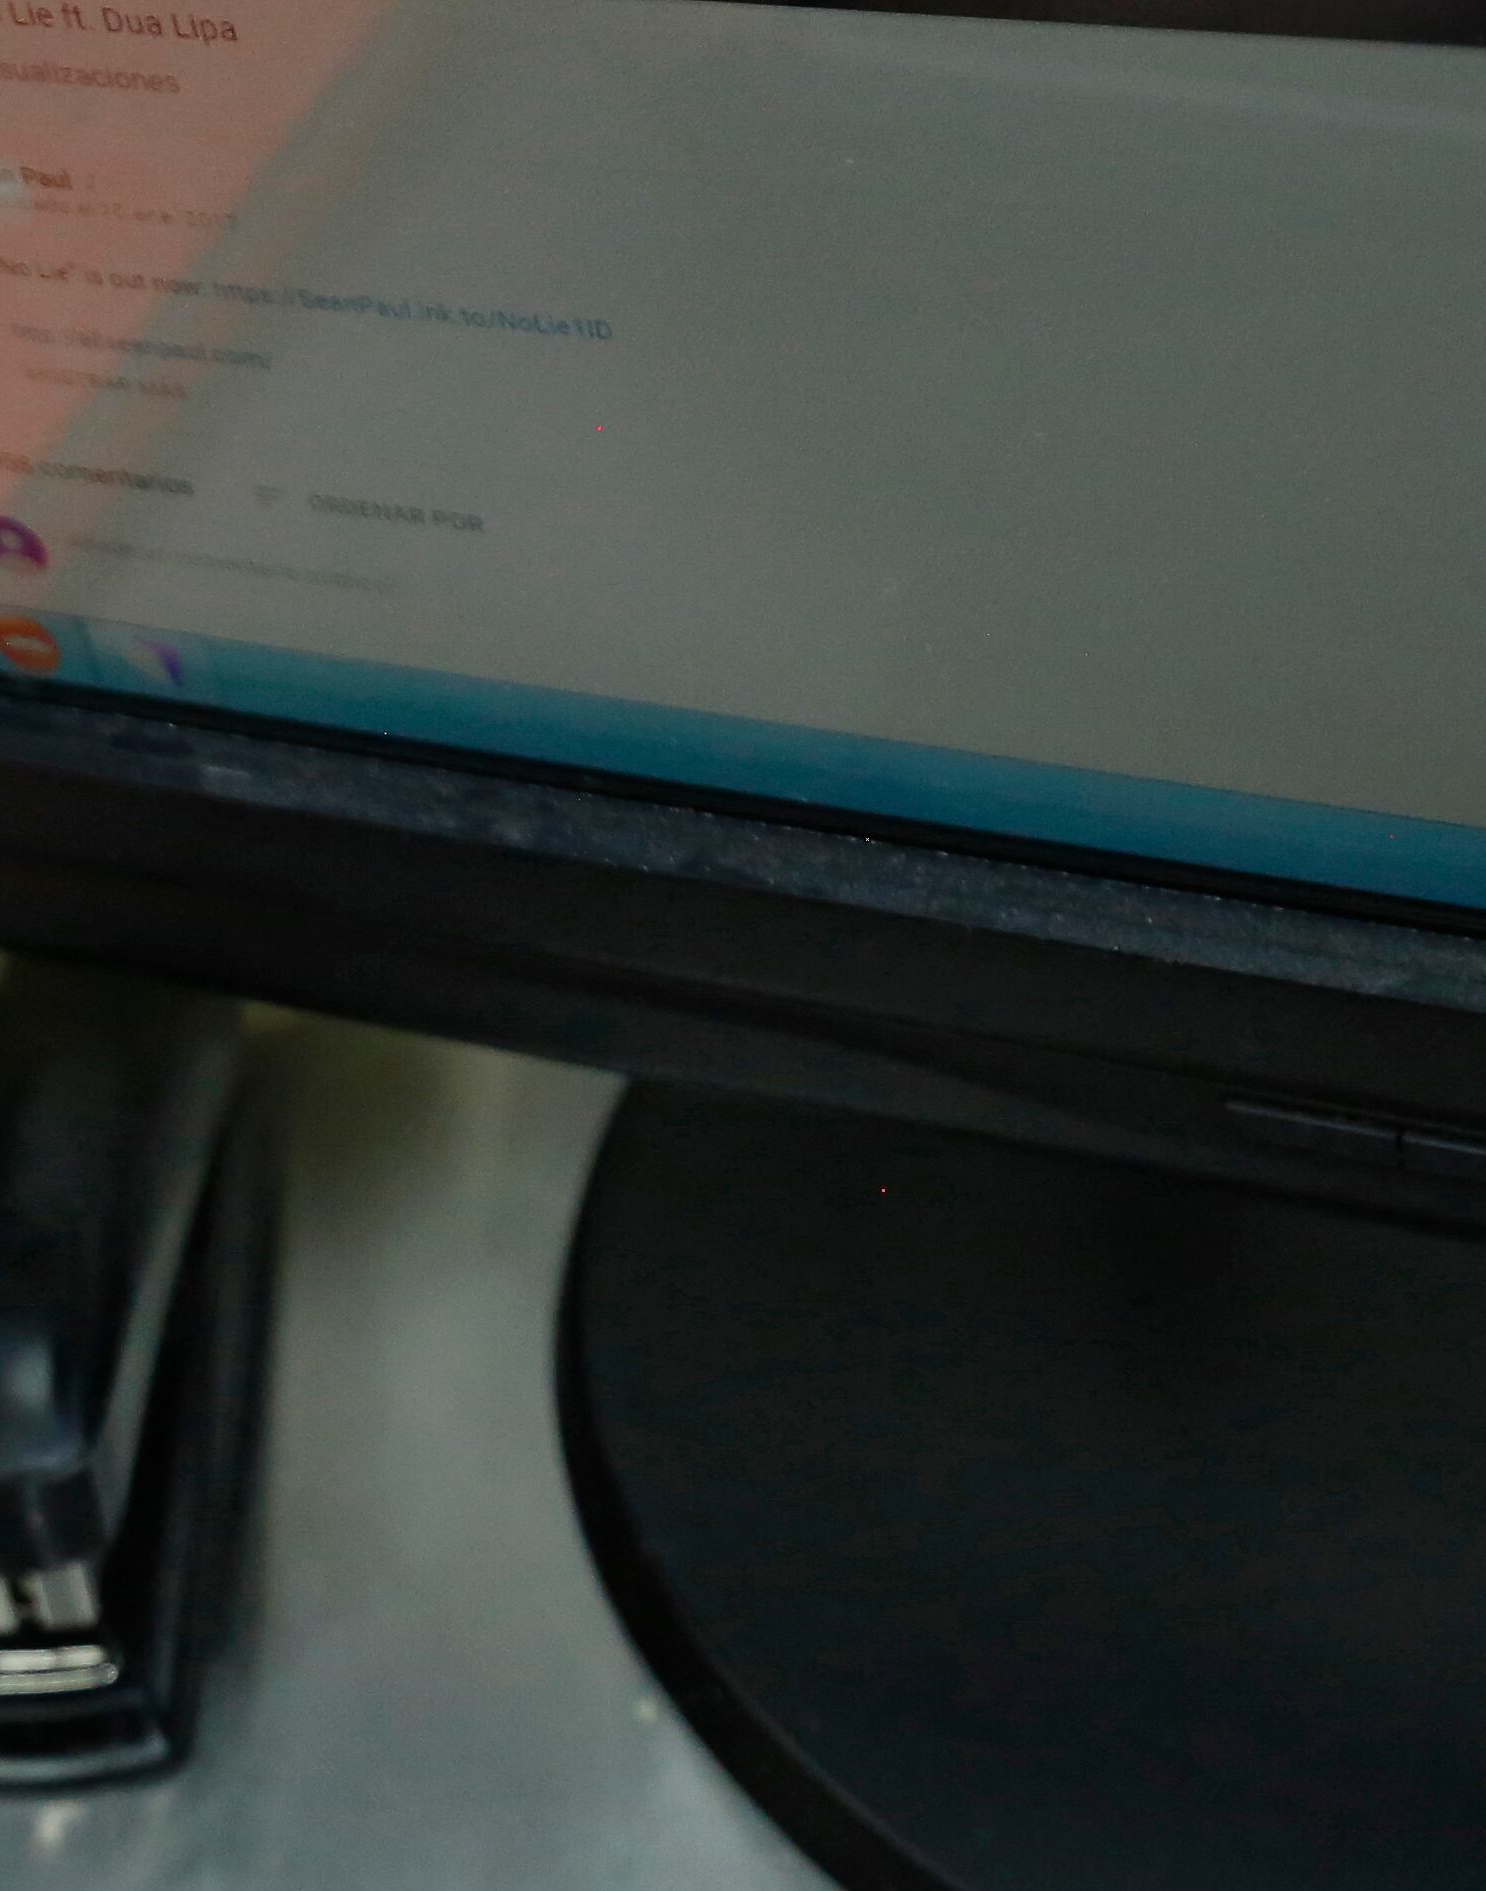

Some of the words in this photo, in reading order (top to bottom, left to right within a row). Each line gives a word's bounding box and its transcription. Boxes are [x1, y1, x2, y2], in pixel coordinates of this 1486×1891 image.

[9, 0, 54, 27] Lie
[101, 6, 163, 36] Dua
[171, 13, 239, 47] Lipa
[20, 165, 73, 190] Paul
[432, 508, 485, 533] POR
